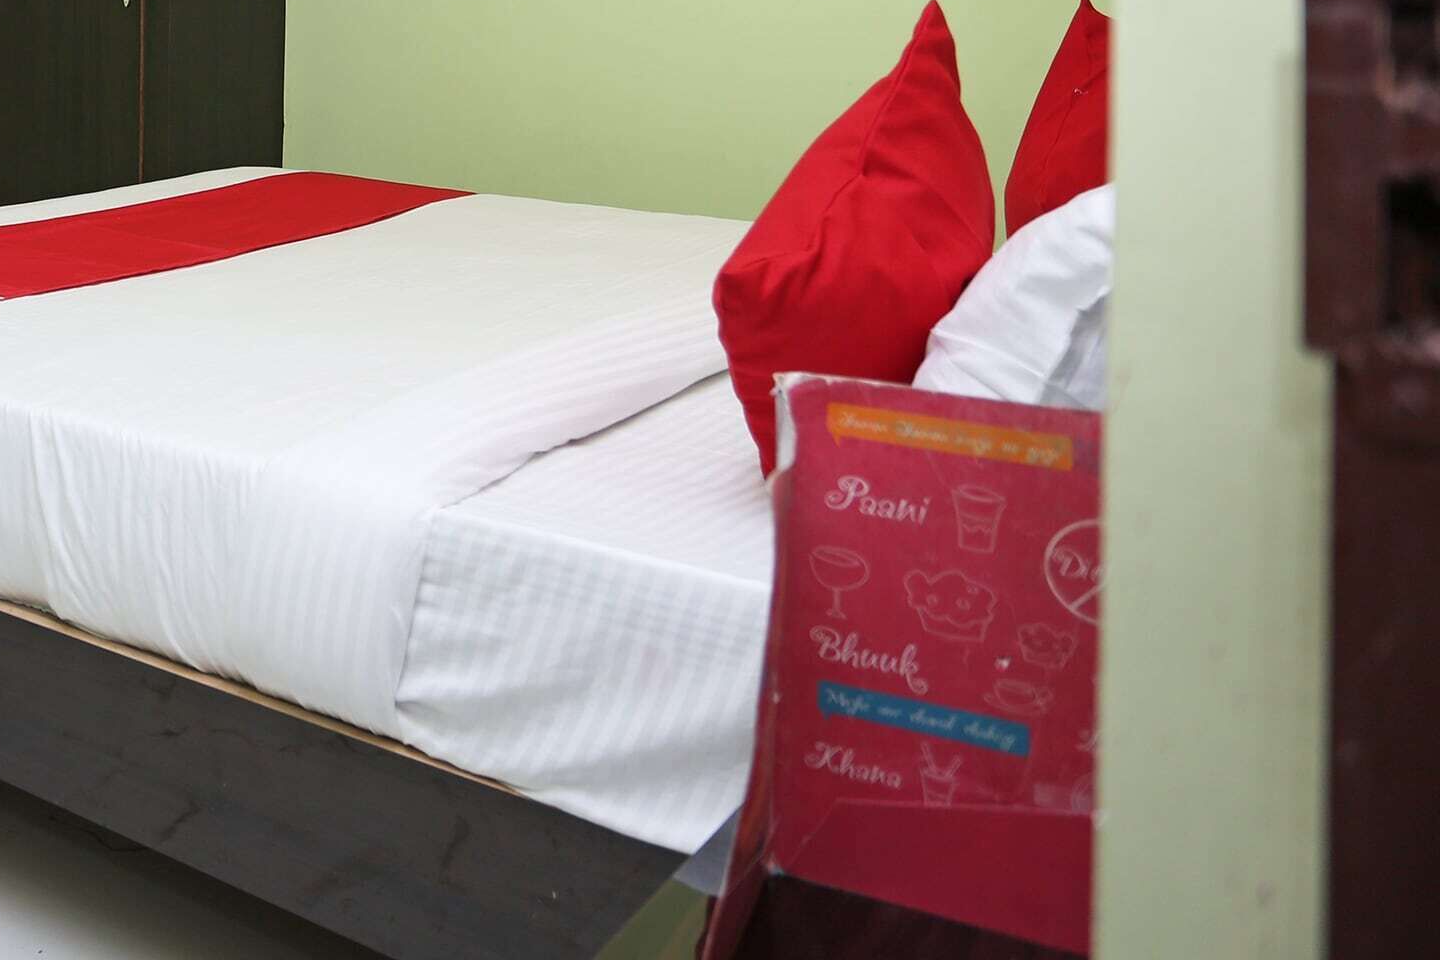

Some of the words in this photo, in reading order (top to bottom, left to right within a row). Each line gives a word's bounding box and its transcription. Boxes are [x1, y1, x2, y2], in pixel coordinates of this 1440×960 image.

[823, 475, 930, 526] Paani
[809, 625, 929, 695] Bhuuk
[803, 740, 902, 790] Khana
